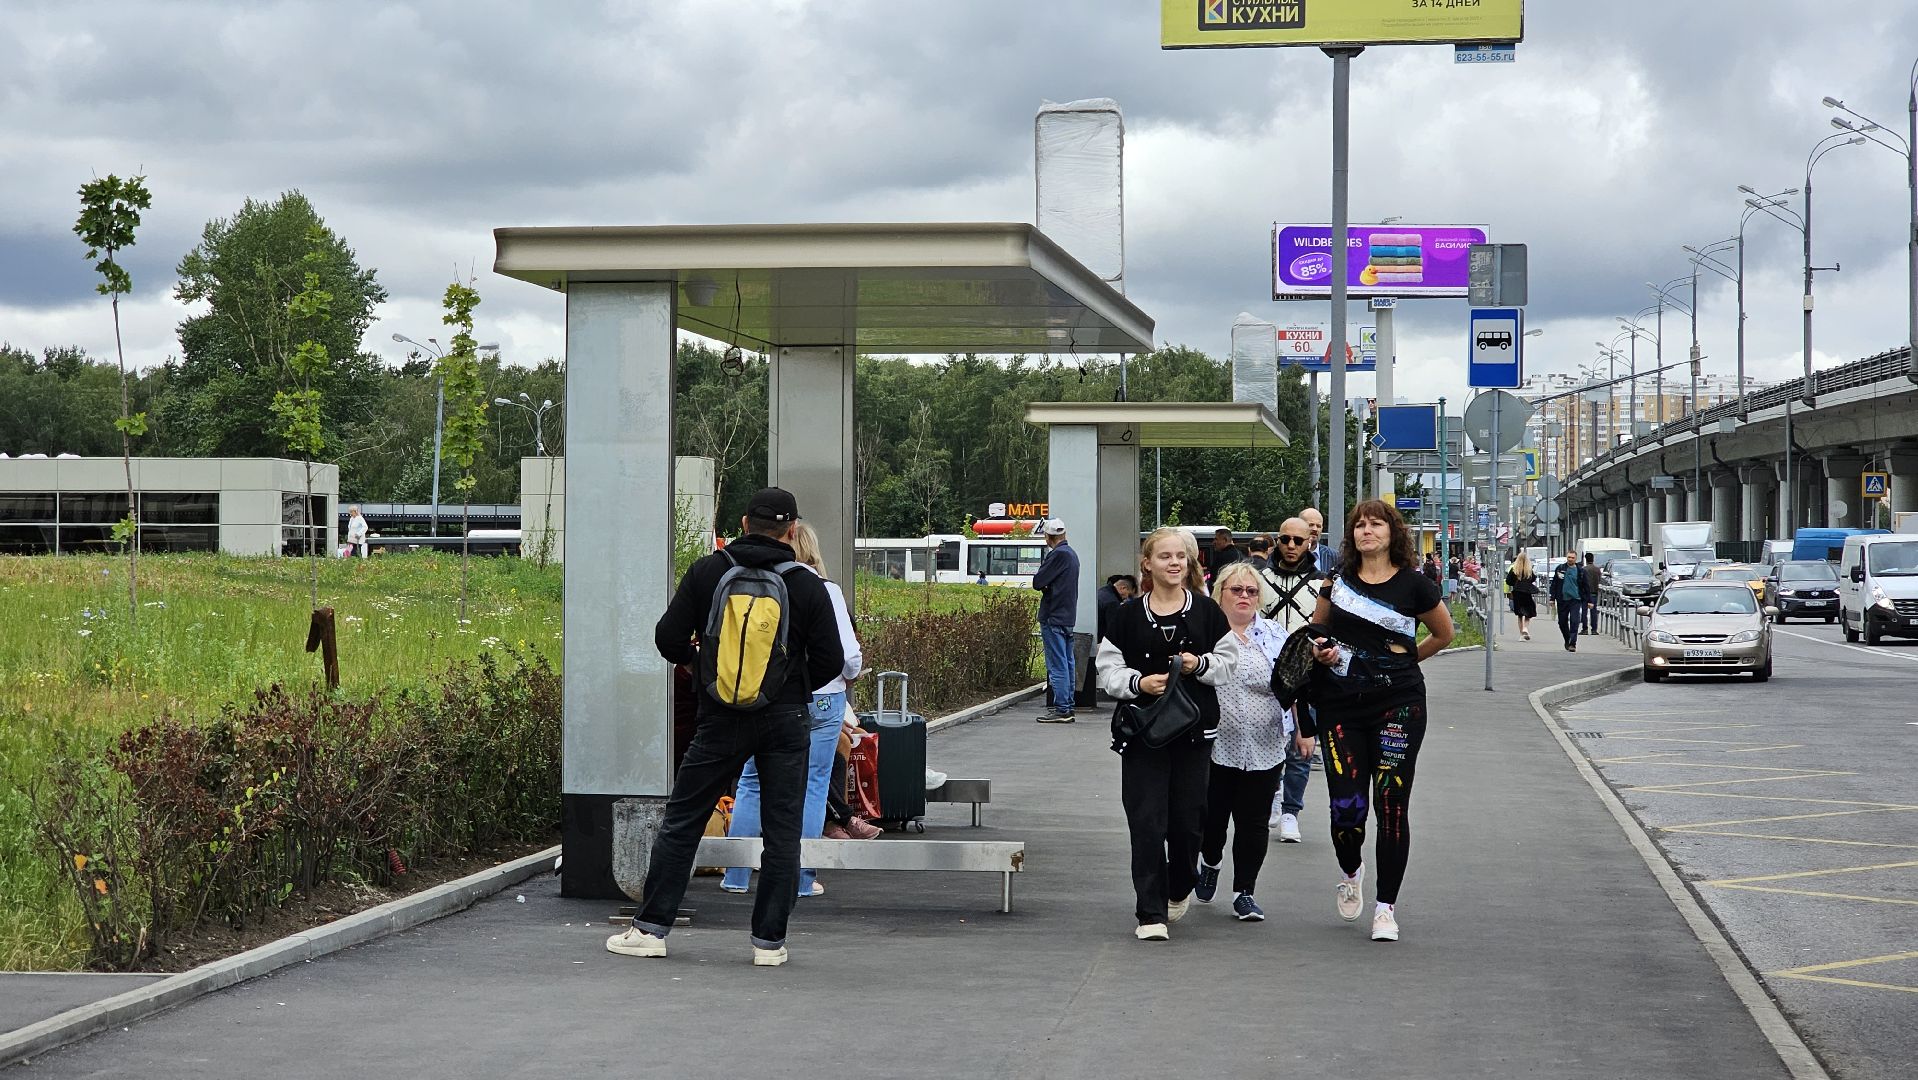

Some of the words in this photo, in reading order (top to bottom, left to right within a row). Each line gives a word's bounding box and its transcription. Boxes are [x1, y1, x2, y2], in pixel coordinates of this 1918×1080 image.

[1412, 0, 1428, 8] ЗА
[1432, 0, 1443, 8] 14
[1232, 6, 1299, 23] КУХНИ
[1456, 52, 1516, 62] 623-55-55.ru
[1294, 237, 1363, 248] WILDBEIES
[1300, 262, 1327, 277] 85%
[1286, 331, 1320, 340] КУХНИ
